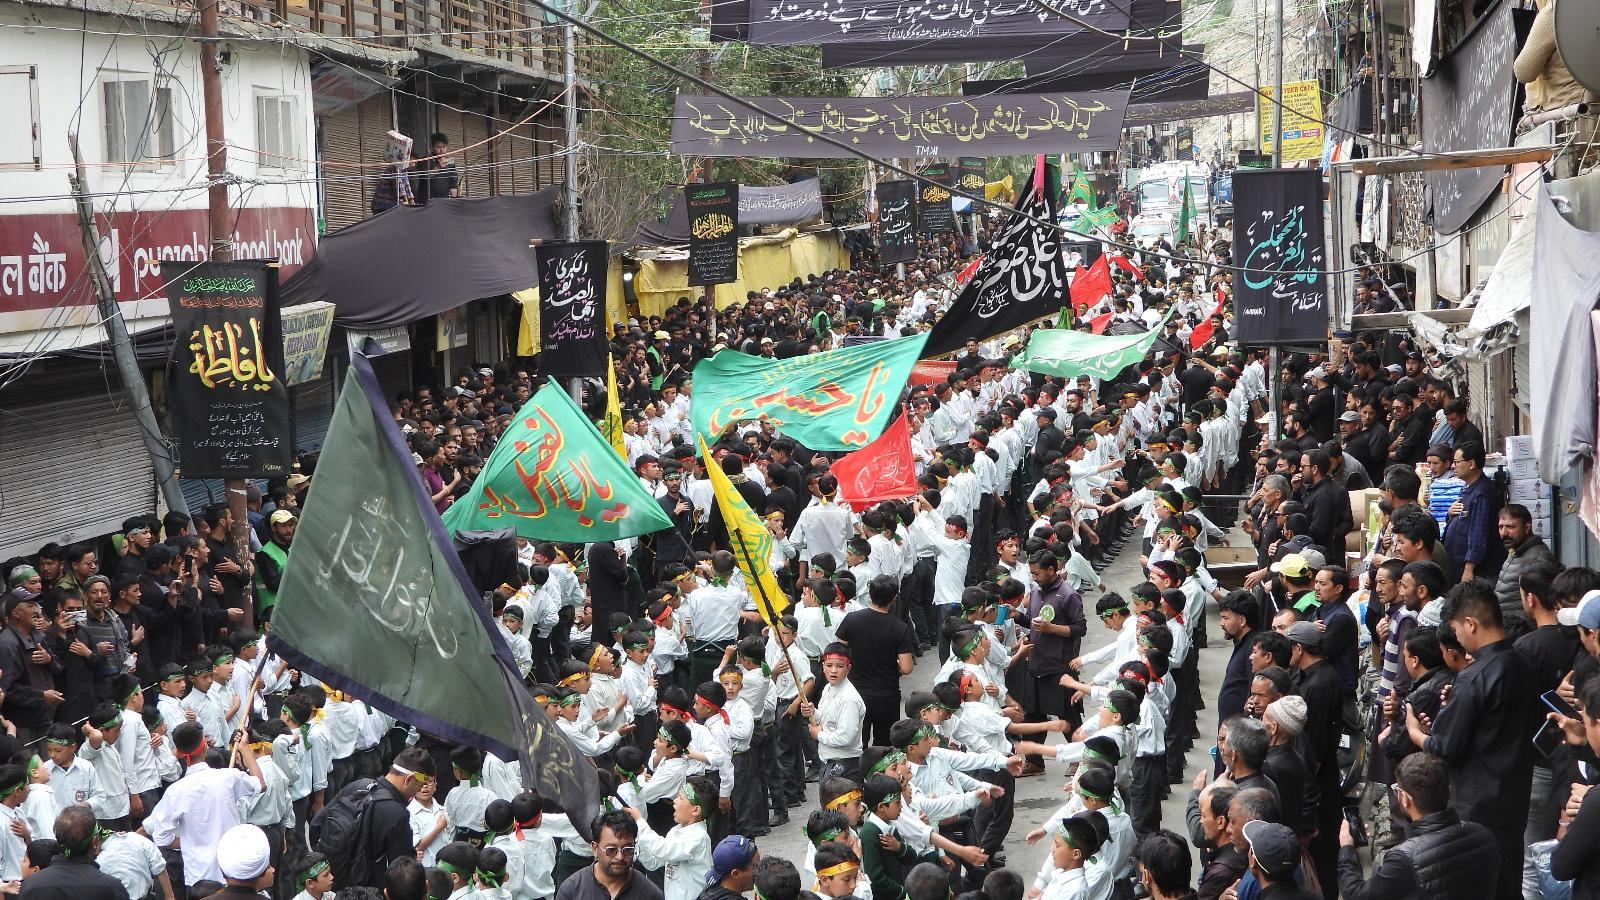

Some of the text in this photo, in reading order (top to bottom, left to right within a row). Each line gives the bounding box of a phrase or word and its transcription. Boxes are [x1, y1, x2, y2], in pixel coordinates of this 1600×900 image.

[28, 231, 67, 294] बैंक
[273, 228, 304, 266] bank
[710, 377, 857, 438] حسین
[842, 360, 886, 445] یا
